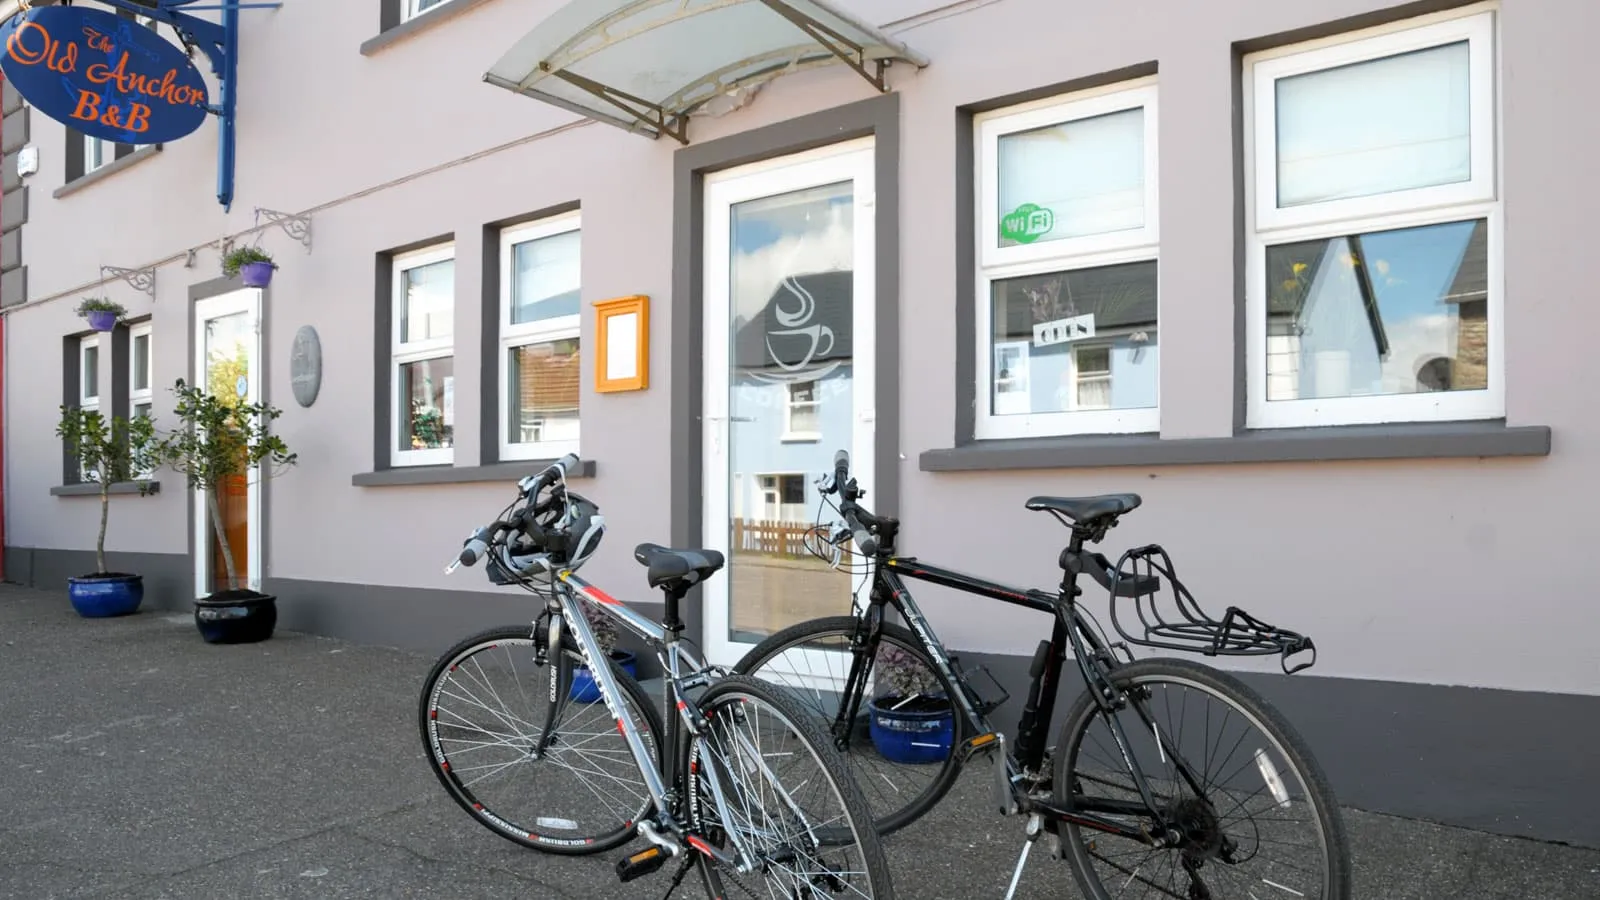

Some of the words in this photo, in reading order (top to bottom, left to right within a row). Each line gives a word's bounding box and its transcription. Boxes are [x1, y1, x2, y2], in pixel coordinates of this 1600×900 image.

[82, 26, 116, 53] The
[6, 22, 79, 74] Old
[86, 50, 205, 106] Anchor
[69, 89, 152, 133] B&B
[1040, 324, 1088, 343] OPEN
[904, 606, 944, 665] JUPITER
